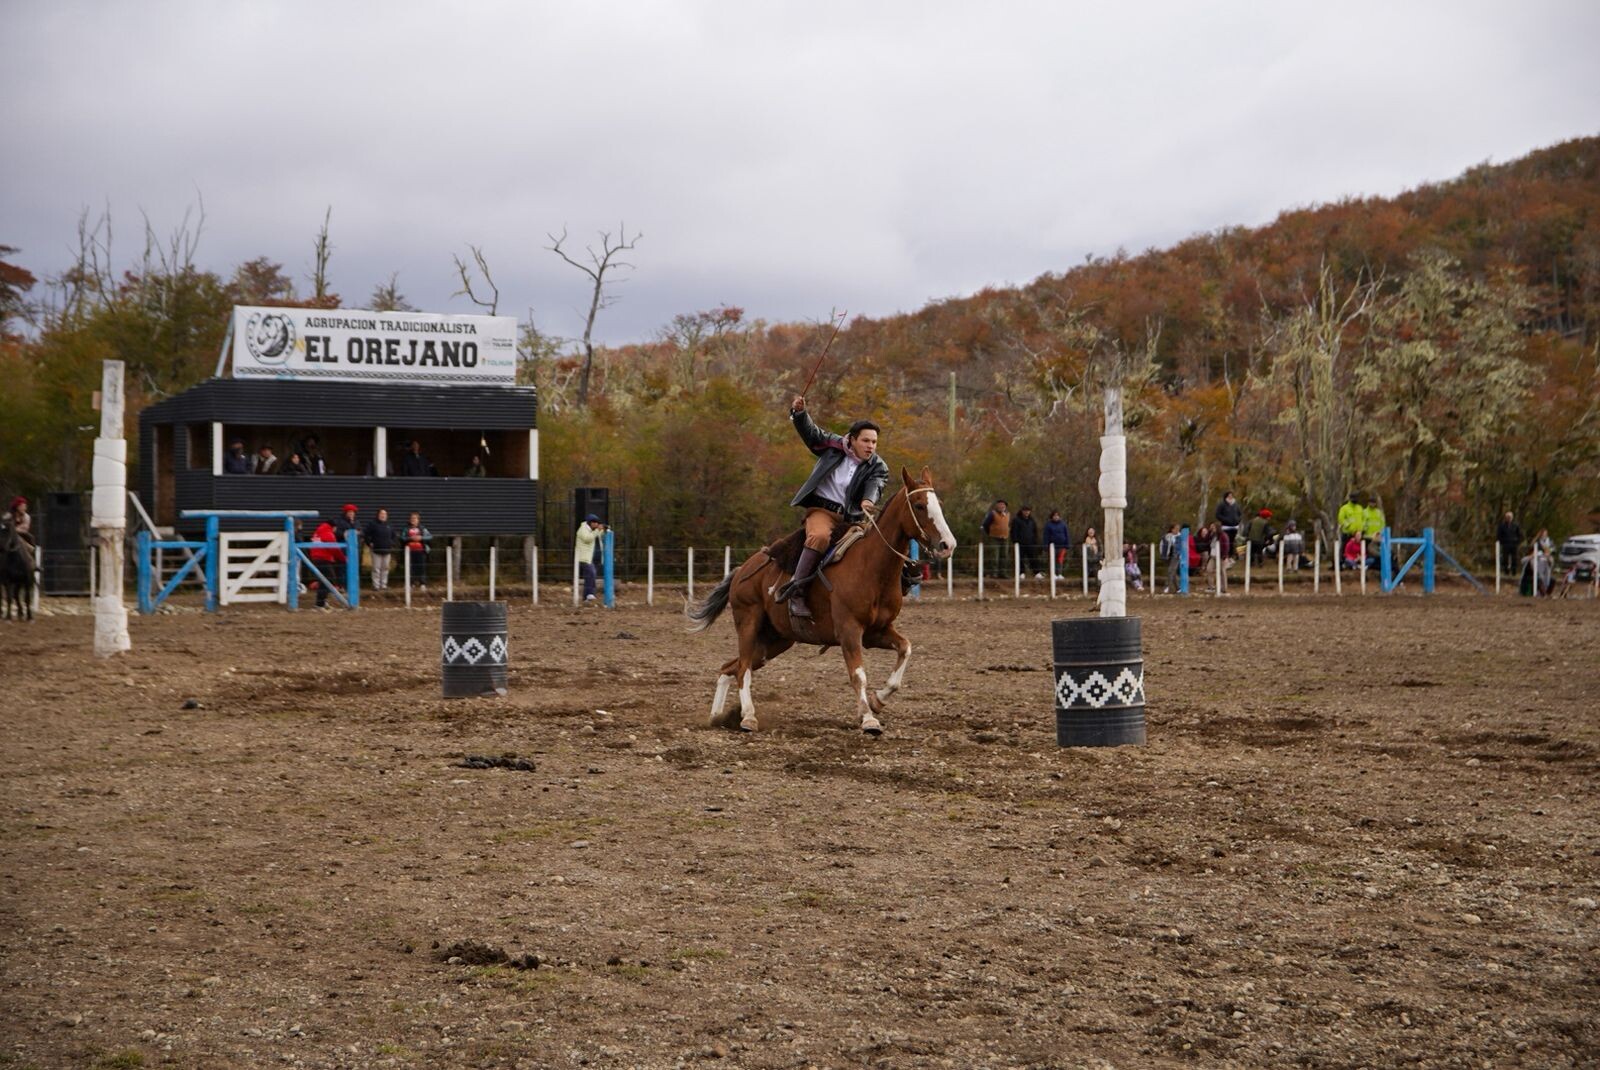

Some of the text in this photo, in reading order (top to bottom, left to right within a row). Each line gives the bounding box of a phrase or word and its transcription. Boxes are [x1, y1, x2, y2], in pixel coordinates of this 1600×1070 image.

[305, 316, 477, 335] AGRUPACION TRADICIONALISTA
[304, 336, 338, 363] EL
[347, 338, 478, 367] OREJANO
